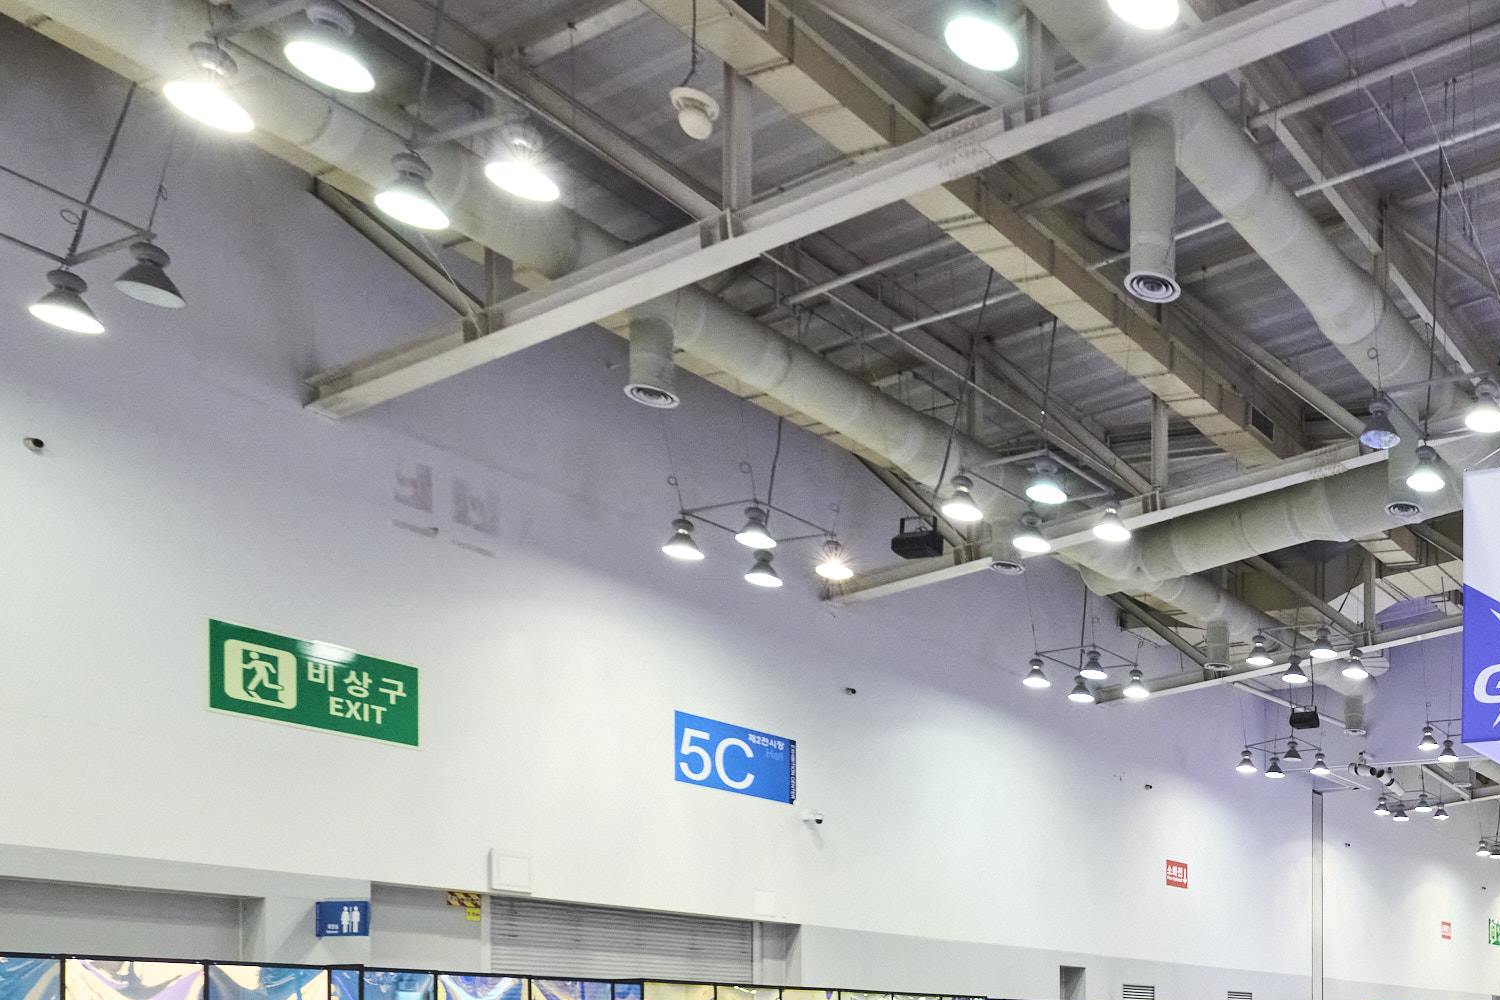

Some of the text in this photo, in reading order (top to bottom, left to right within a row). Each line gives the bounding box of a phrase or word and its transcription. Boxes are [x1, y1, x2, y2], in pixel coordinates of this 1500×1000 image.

[307, 660, 407, 705] 비상구
[329, 696, 387, 724] EXIT
[679, 727, 755, 790] 5C
[747, 733, 785, 751] 제2전시장
